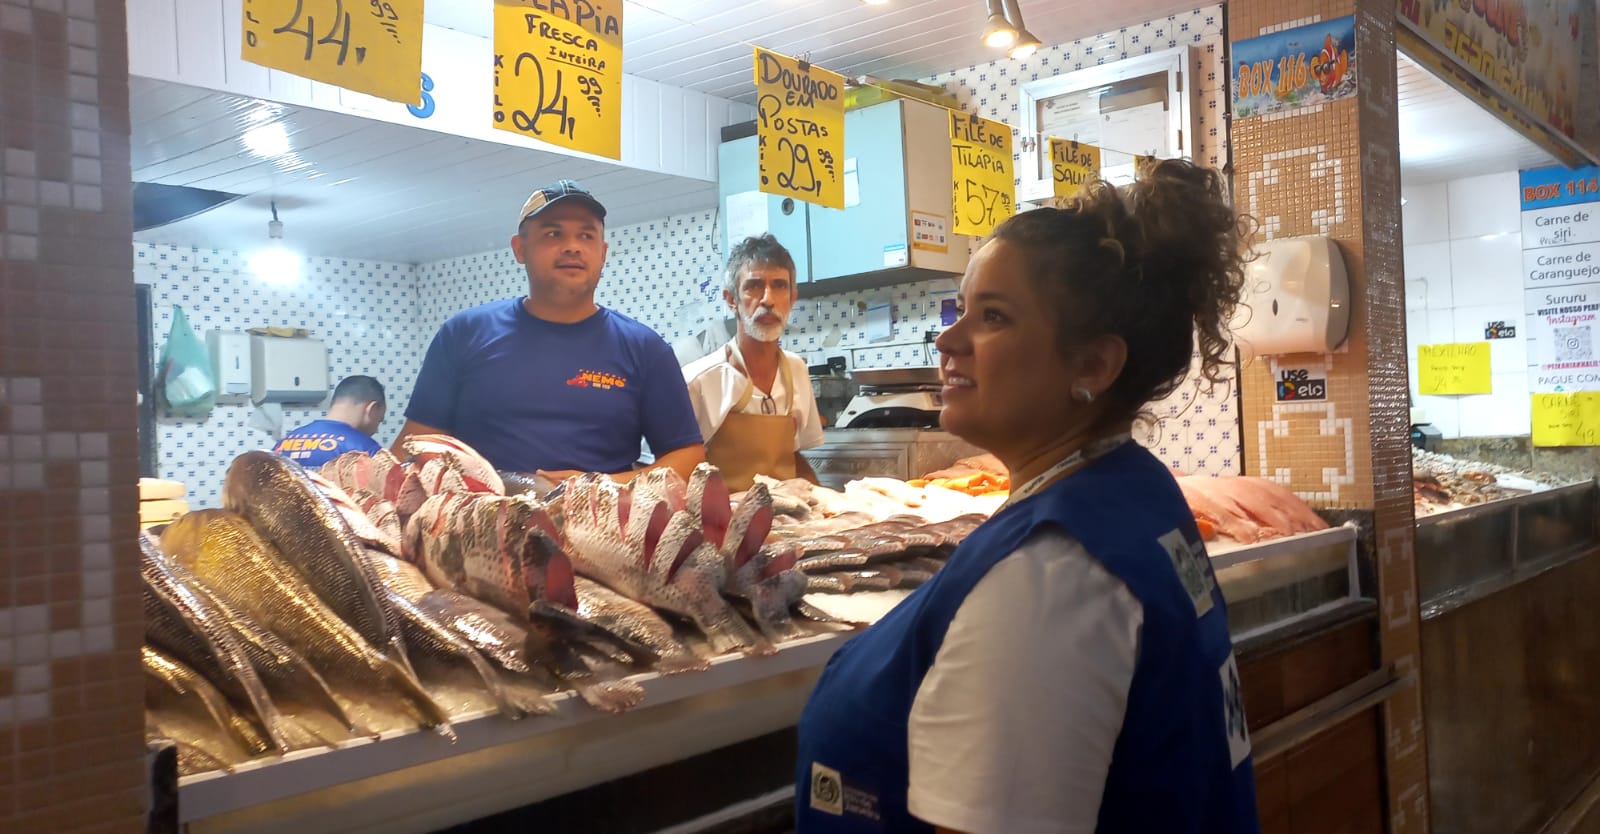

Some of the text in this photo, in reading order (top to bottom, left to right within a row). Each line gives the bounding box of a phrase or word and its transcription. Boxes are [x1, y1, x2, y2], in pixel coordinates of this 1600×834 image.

[525, 14, 598, 51] FRESCA
[759, 53, 838, 100] DOURADO
[1239, 52, 1307, 99] BOX 116
[785, 91, 815, 109] EM
[758, 94, 829, 138] POSTAS
[989, 134, 1004, 149] DE
[1080, 153, 1092, 167] DE
[1523, 177, 1599, 202] BOX 114
[1535, 211, 1589, 227] Carne de
[1553, 227, 1572, 240] siri
[1536, 251, 1592, 266] Carne de
[1529, 265, 1600, 281] Caranguejo
[1545, 293, 1587, 306] Sururu
[1537, 307, 1558, 316] VISITE
[1560, 305, 1582, 314] NOSSO
[1546, 314, 1596, 326] Instagram
[582, 372, 625, 388] NEMO
[1537, 374, 1573, 385] PAGUE
[281, 438, 338, 451] NEMO
